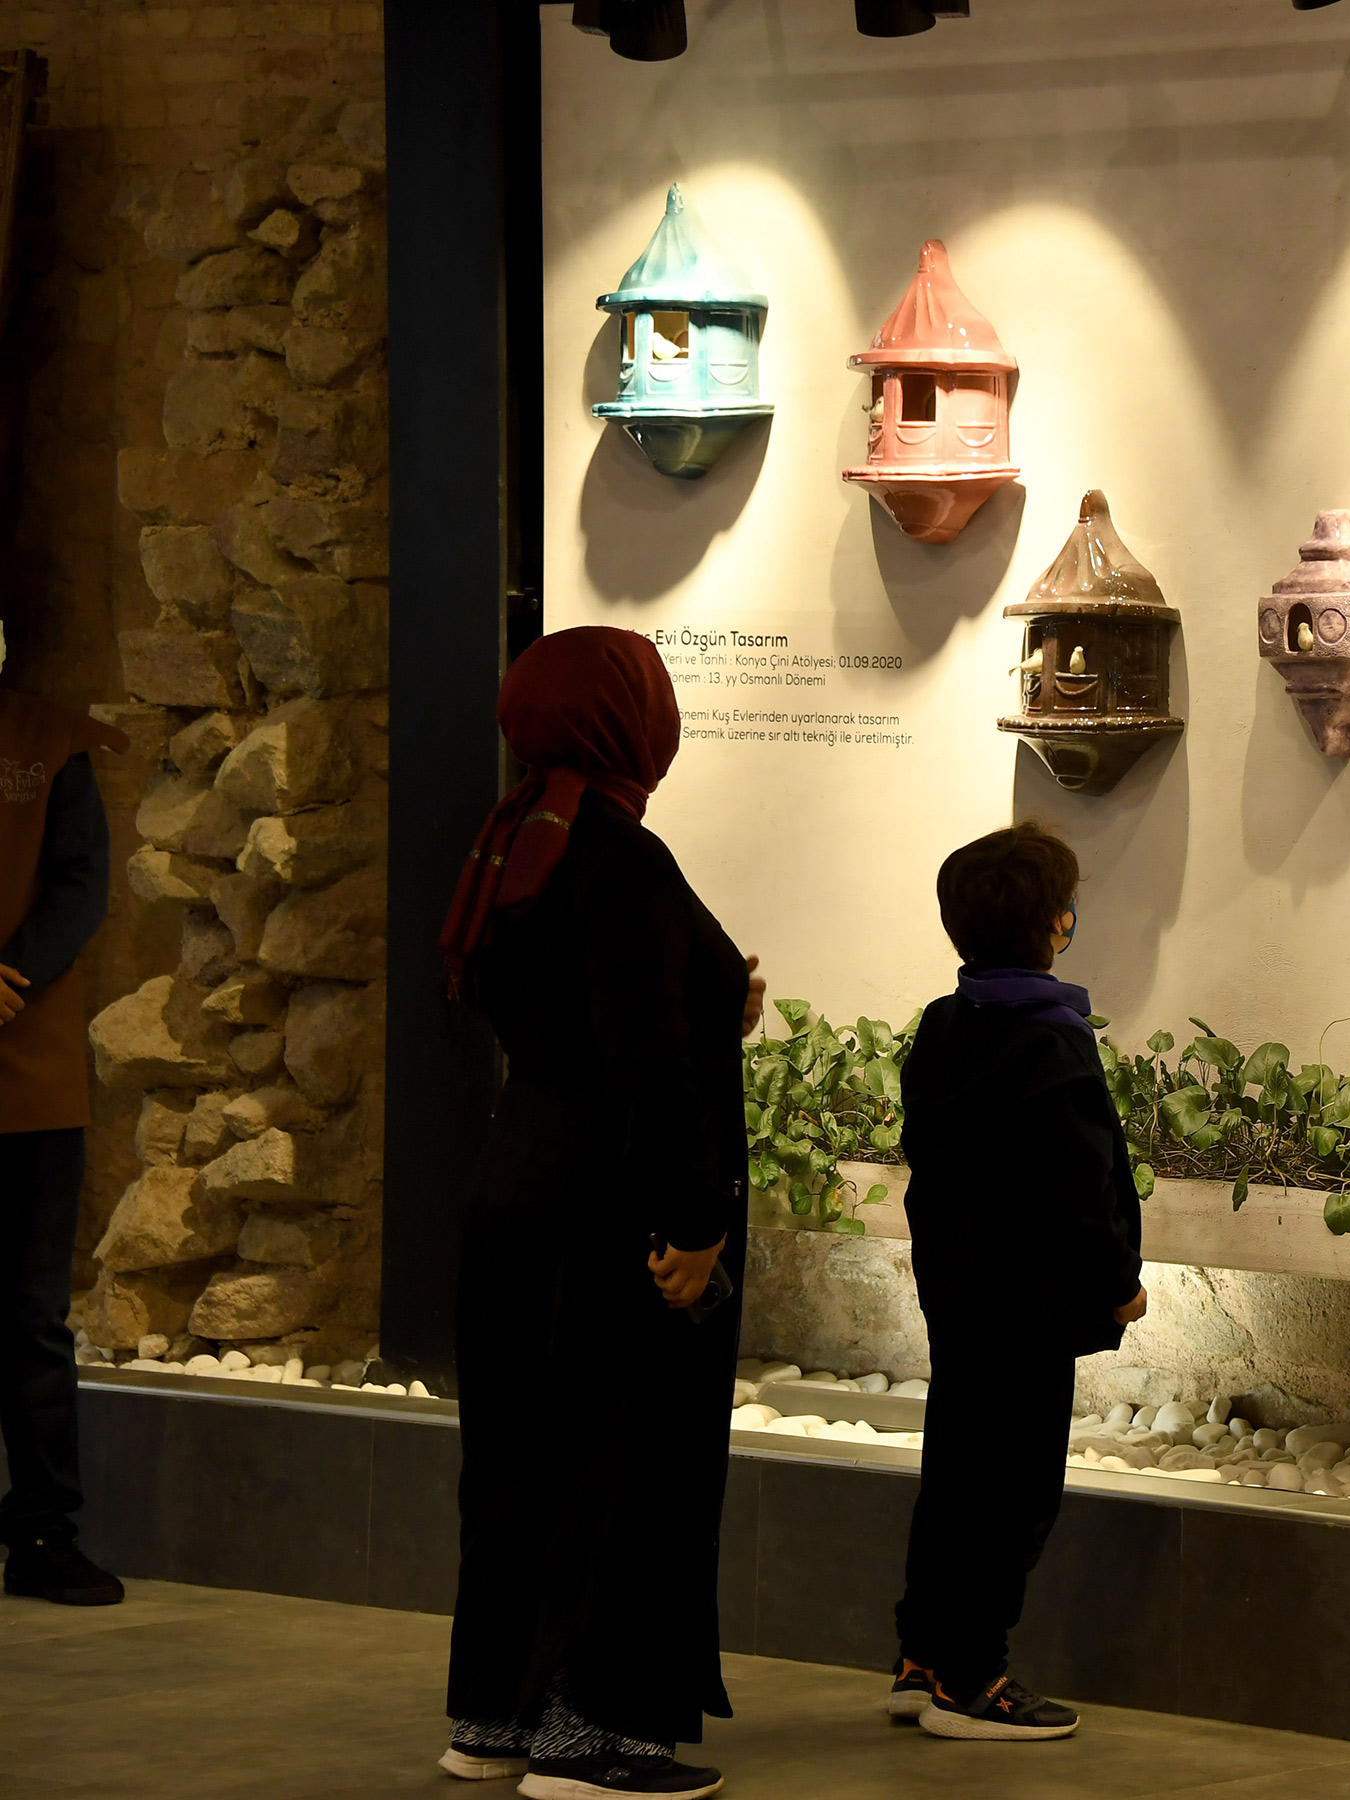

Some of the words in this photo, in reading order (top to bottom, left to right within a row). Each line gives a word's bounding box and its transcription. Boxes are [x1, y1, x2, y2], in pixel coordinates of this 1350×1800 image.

[656, 630, 676, 645] Evi
[681, 626, 726, 652] Özgün
[730, 631, 788, 647] Tasarım
[663, 653, 682, 665] Yeri
[685, 656, 697, 665] ve
[699, 654, 727, 665] Tarihi
[735, 654, 767, 669] Konya
[770, 654, 789, 670] Çini
[839, 656, 902, 669] 01.09.2020
[668, 671, 700, 684] önem
[709, 672, 723, 684] 13.
[724, 675, 739, 687] yy
[740, 672, 784, 685] Osmanlı
[786, 673, 825, 686] Dönemi
[679, 709, 709, 721] önemi
[712, 710, 730, 726] Kuş
[733, 710, 788, 724] Evlerinden
[791, 712, 857, 727] uyarlanarak
[858, 714, 899, 727] tasarım
[682, 726, 727, 739] Seramik
[728, 728, 767, 741] üzerine
[768, 730, 782, 741] sır
[783, 730, 801, 741] altı
[802, 730, 839, 747] tekniği
[840, 730, 852, 743] ile
[855, 731, 914, 748] üretilmiştir.
